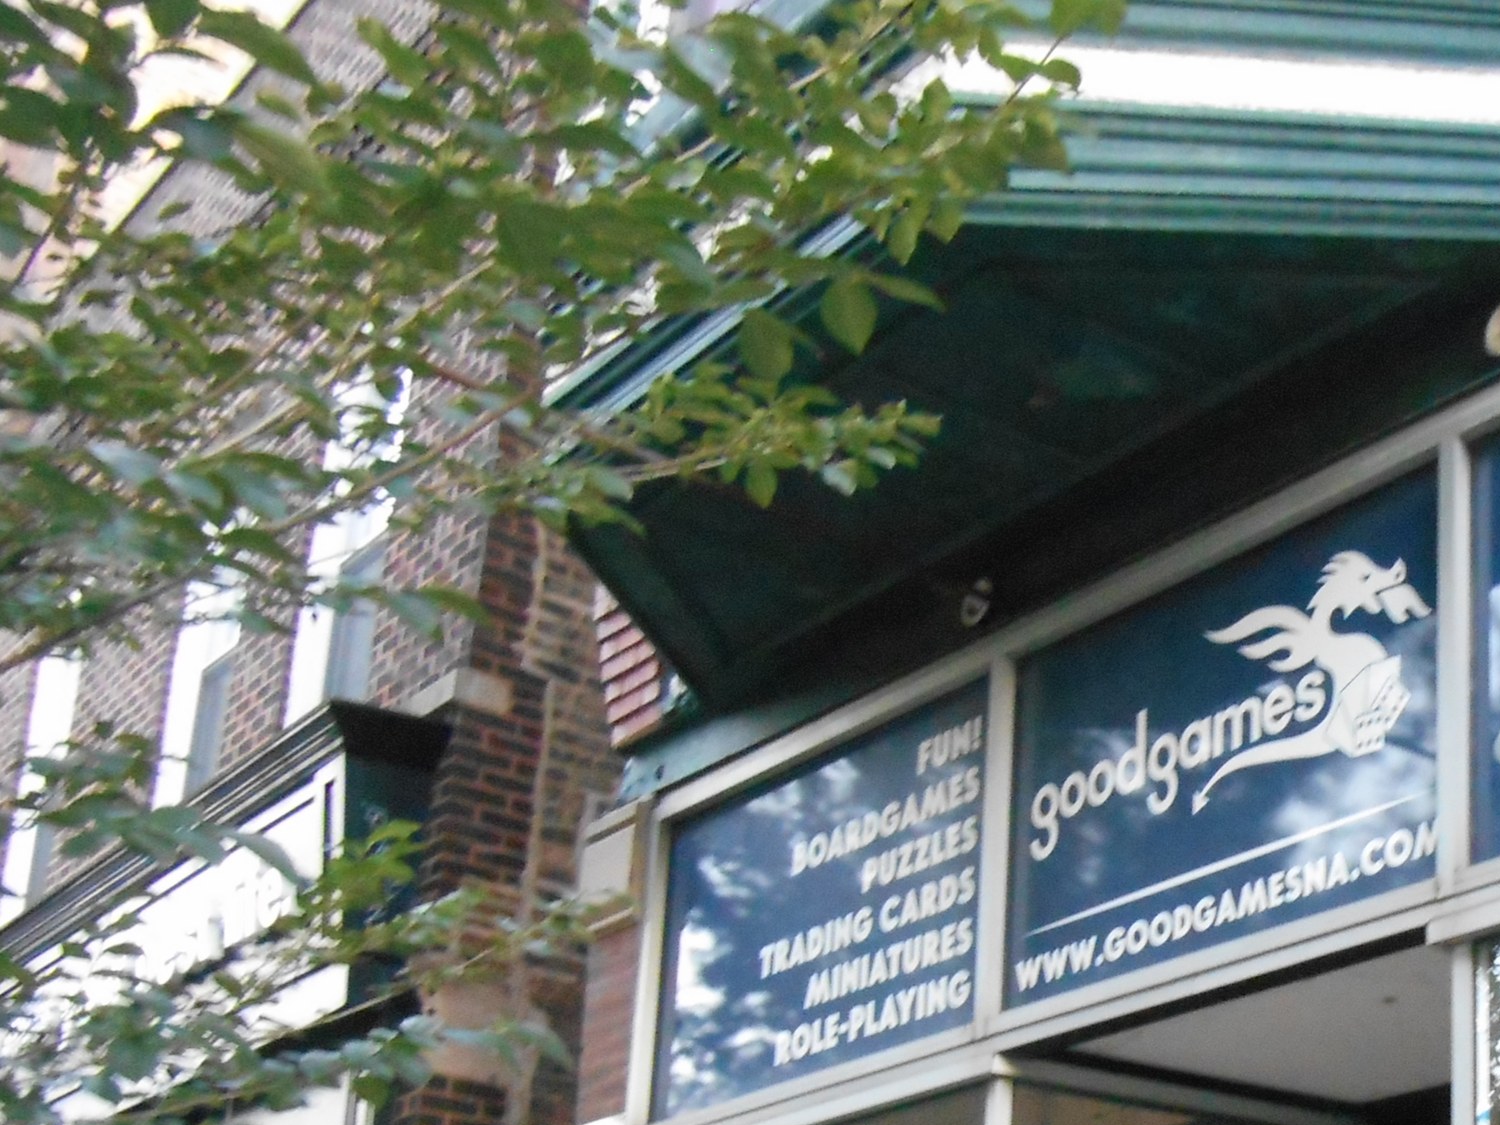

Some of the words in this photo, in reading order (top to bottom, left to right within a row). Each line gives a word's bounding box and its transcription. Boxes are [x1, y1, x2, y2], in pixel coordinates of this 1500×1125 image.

[915, 714, 984, 777] FUN!
[1030, 669, 1327, 862] goodgames
[790, 765, 981, 878] BOARDGAMES
[860, 814, 979, 895] PUZZLES
[758, 905, 874, 980] TRADING
[878, 866, 976, 934] CARDS
[1014, 819, 1438, 993] WWW.GOODGAMESNA.COM
[803, 917, 975, 1011] MINIATURES
[772, 969, 973, 1068] ROLE-PLAYING
